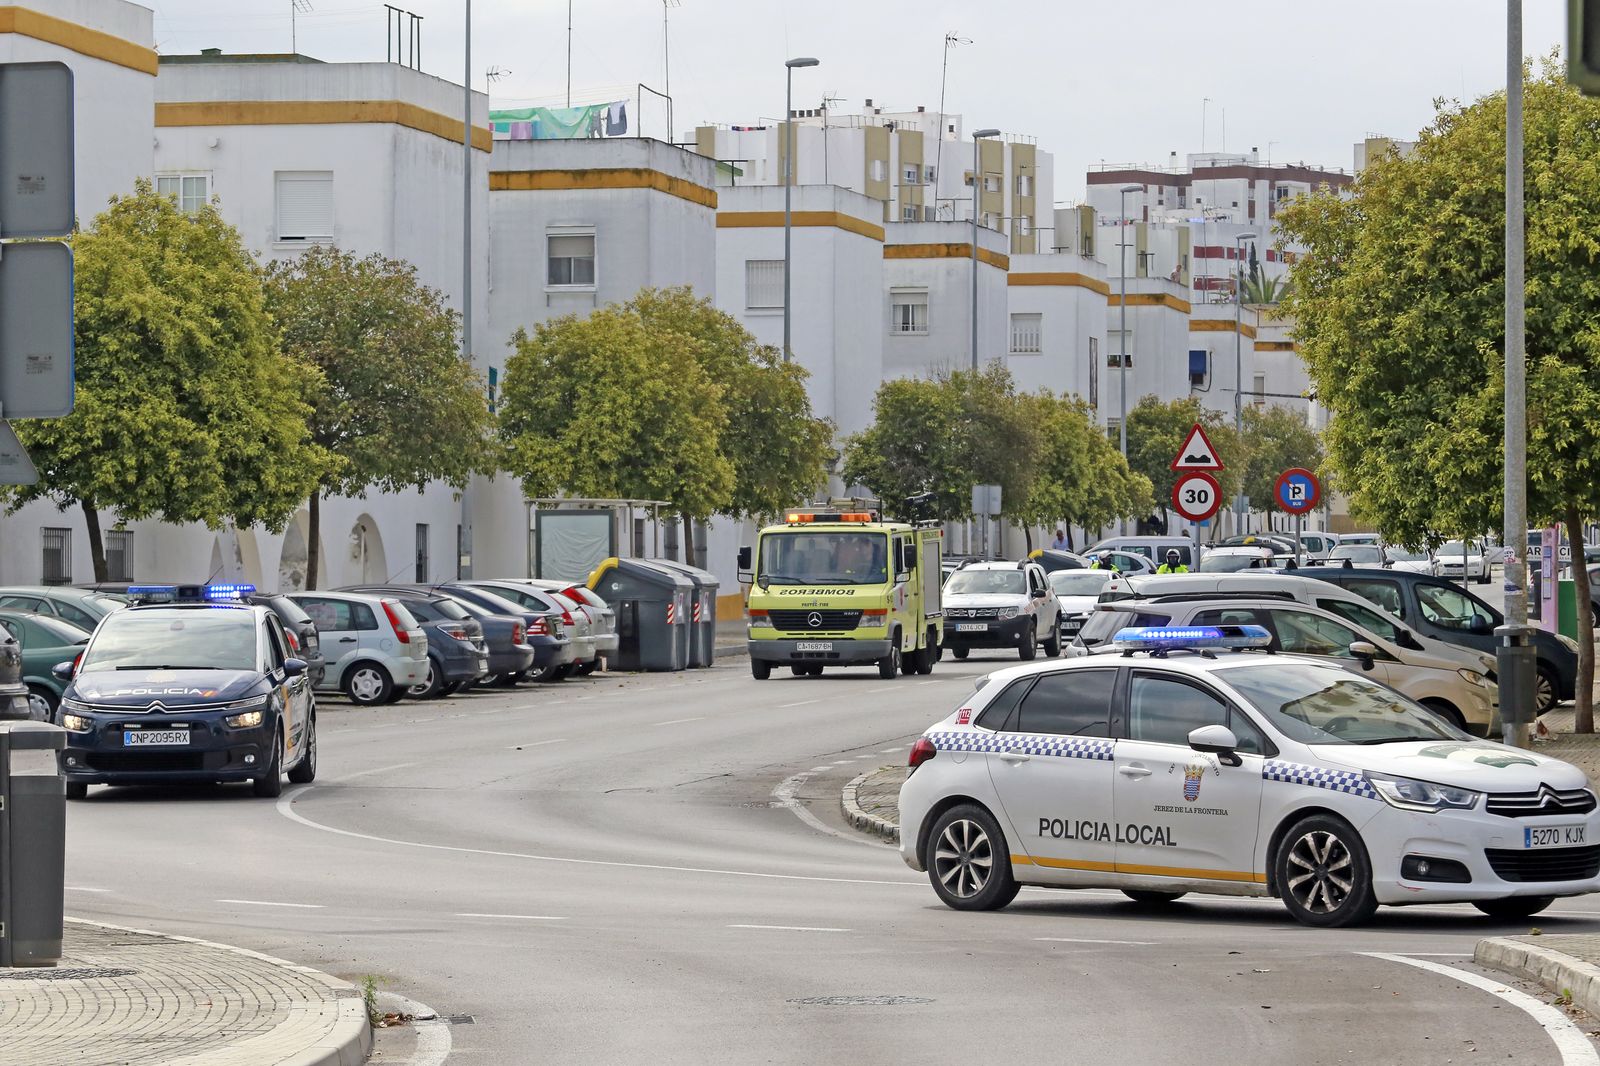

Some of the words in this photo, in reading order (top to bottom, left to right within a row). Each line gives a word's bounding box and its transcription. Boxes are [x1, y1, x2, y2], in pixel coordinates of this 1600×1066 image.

[1184, 489, 1208, 504] 30
[1292, 486, 1301, 498] P
[1153, 804, 1174, 813] JEREZ
[1184, 806, 1193, 814] LA
[1193, 807, 1229, 816] FRONTERA
[1038, 817, 1111, 842] POLICIA
[1115, 823, 1177, 847] LOCAL
[1532, 829, 1560, 846] 5270
[1565, 827, 1585, 843] KJX
